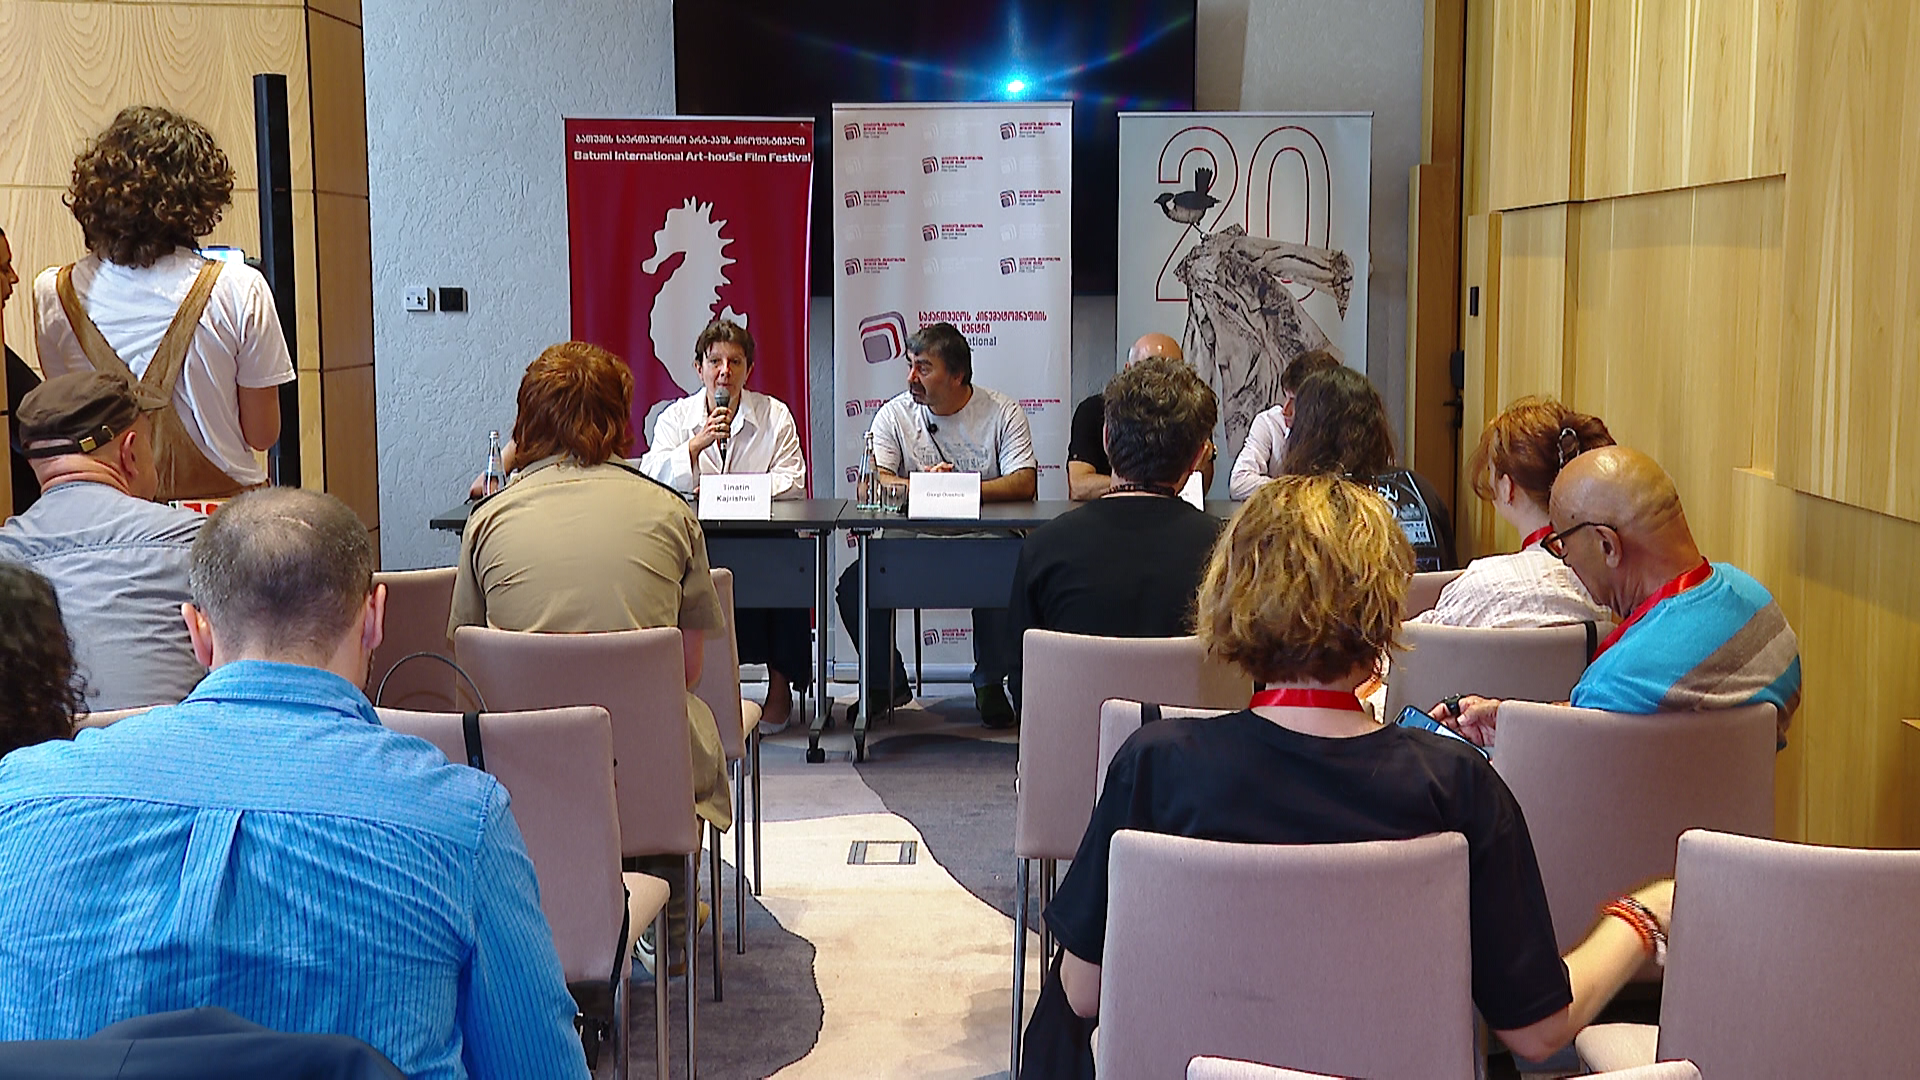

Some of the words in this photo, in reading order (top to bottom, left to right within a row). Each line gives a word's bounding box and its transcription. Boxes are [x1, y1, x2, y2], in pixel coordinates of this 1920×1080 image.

[574, 150, 613, 161] Batumi
[615, 151, 684, 162] International
[745, 152, 767, 162] Film
[769, 152, 811, 163] Festival
[965, 336, 997, 346] ational
[723, 483, 750, 491] Tinatin
